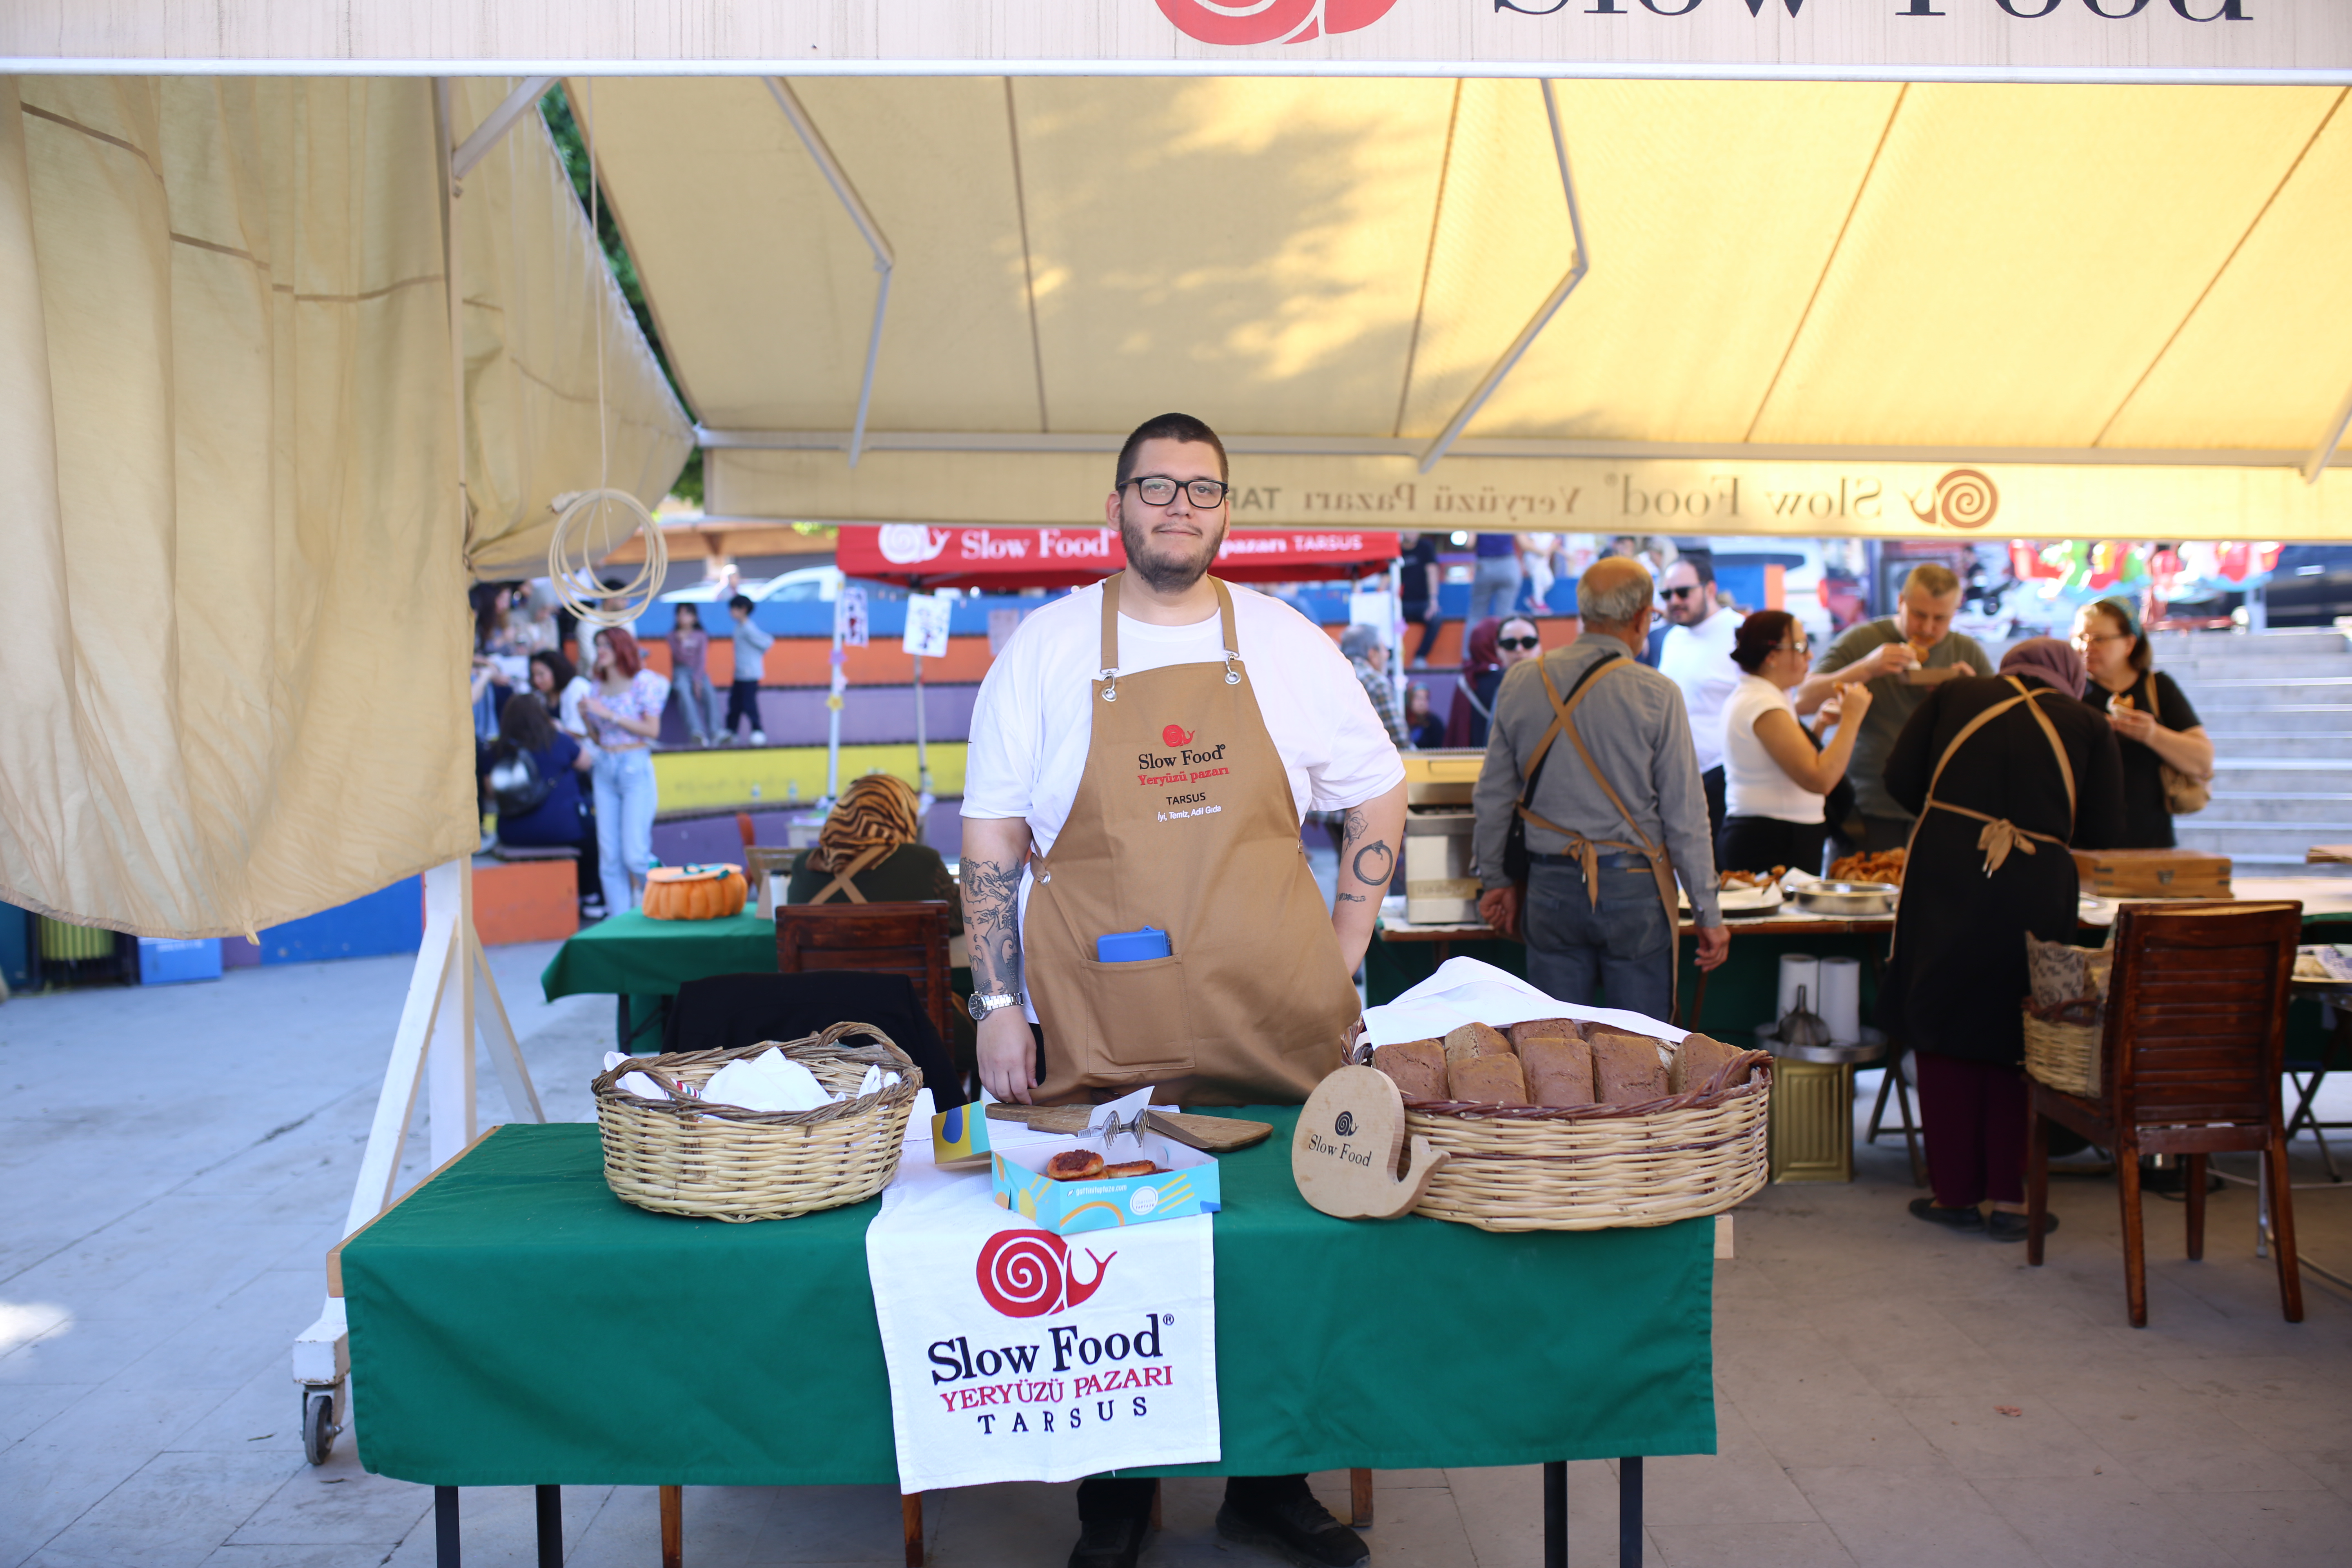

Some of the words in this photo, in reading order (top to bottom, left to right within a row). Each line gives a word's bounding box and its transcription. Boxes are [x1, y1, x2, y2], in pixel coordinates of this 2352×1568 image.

[960, 529, 1031, 559] Slow
[1292, 534, 1363, 552] TARSUS
[1138, 753, 1177, 770] Slow
[1137, 771, 1188, 787] Yeryüzü
[1189, 767, 1229, 783] pazarı
[1166, 792, 1206, 805] TARSUS
[1191, 806, 1204, 817] Adil
[1205, 804, 1222, 814] Gıda
[1308, 1134, 1338, 1156] Slow
[1339, 1143, 1372, 1167] Food
[1076, 1184, 1127, 1197] gattinitaptaze.com
[927, 1336, 1040, 1385] Slow
[940, 1379, 1064, 1413] YERYÜZÜ
[1074, 1365, 1174, 1399] PAZARI
